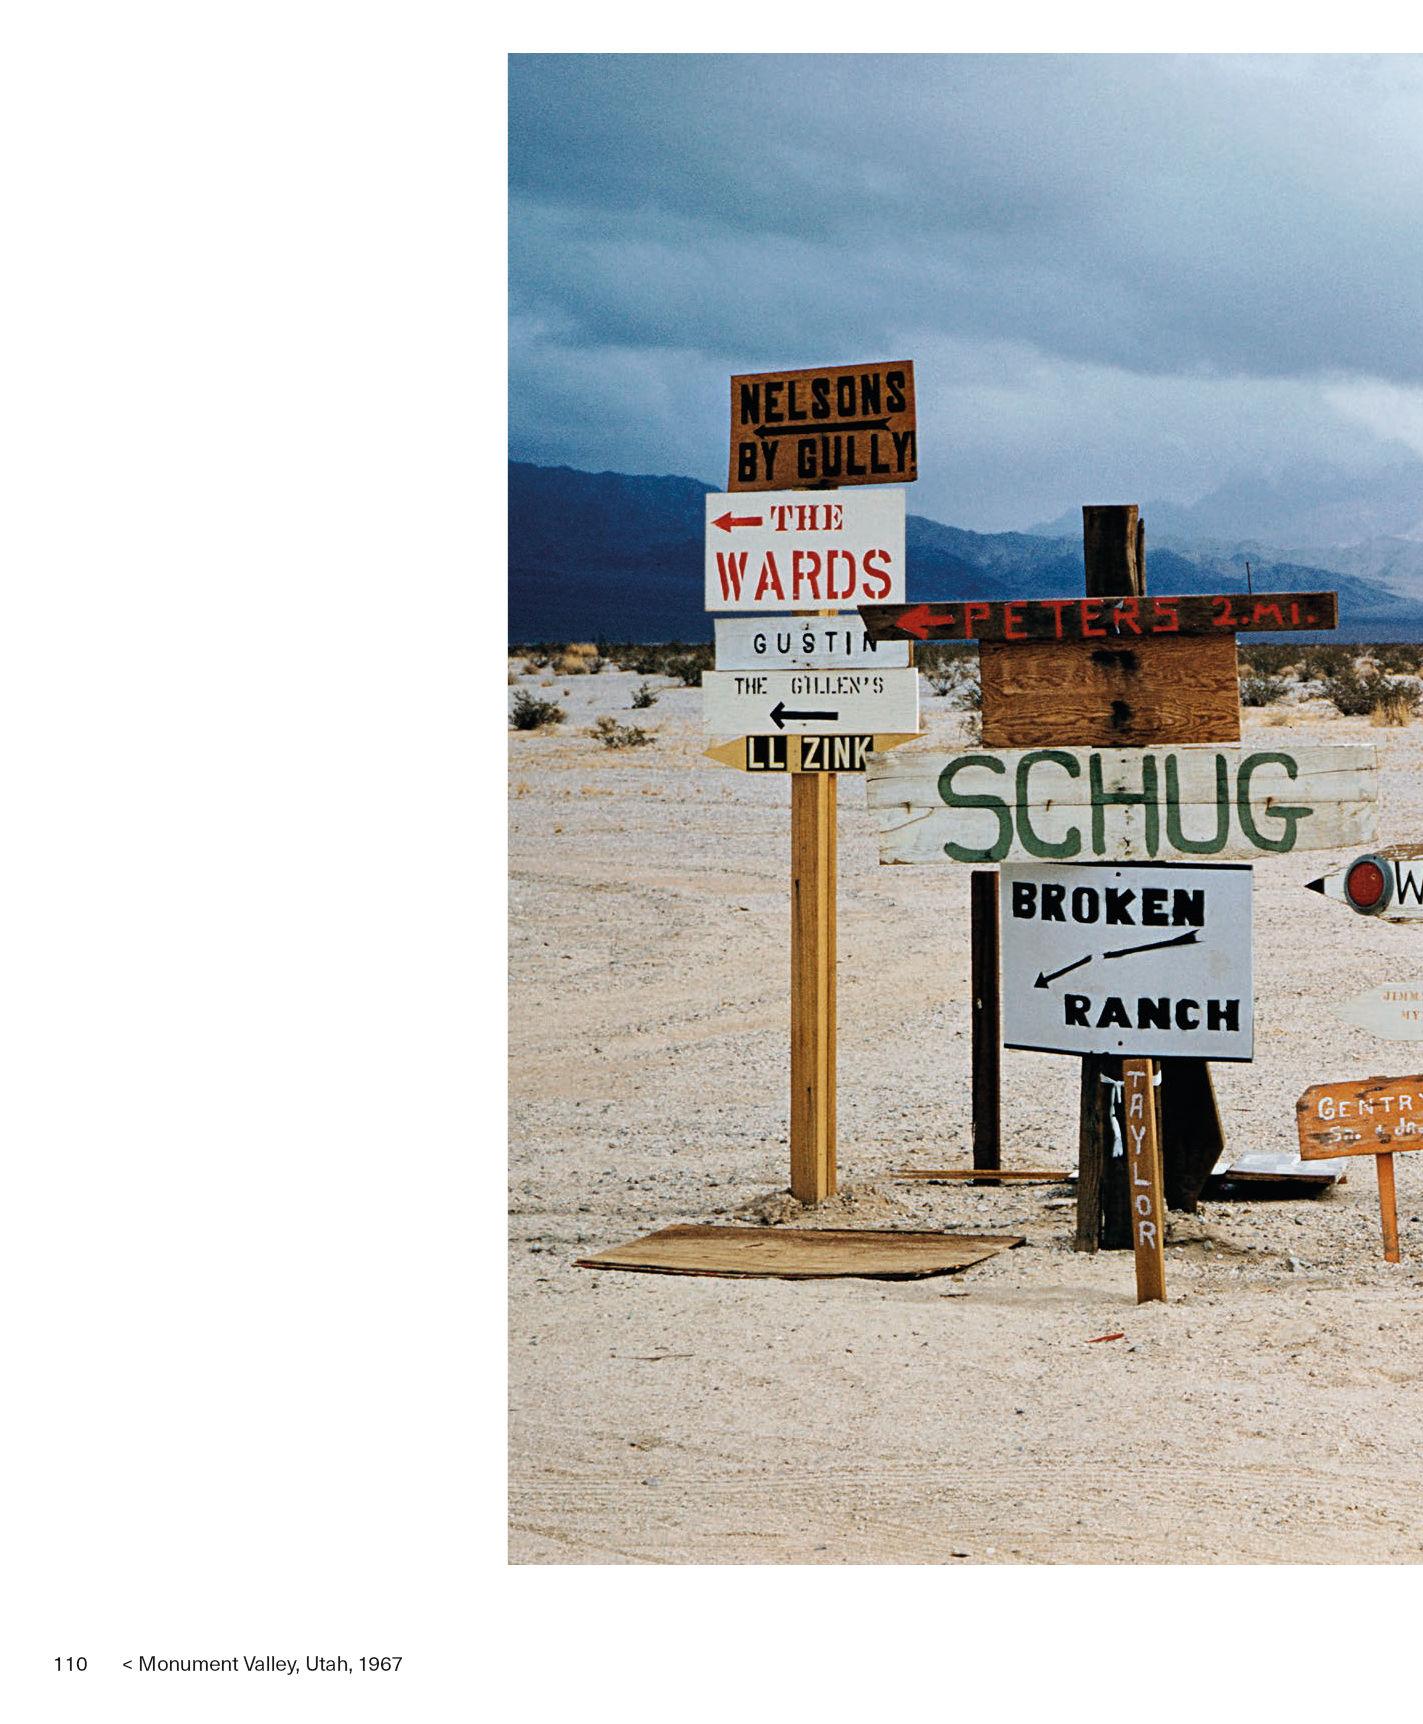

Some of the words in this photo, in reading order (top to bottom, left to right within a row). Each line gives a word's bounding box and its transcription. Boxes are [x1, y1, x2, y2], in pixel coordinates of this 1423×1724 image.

[740, 371, 906, 425] NELSONS
[738, 440, 778, 482] BY
[797, 431, 916, 479] GULLY!
[770, 504, 843, 532] THE
[716, 549, 893, 602] WARDS
[963, 598, 1181, 640] PETERS
[753, 631, 878, 655] GUSTIN
[734, 677, 768, 695] THE
[791, 676, 884, 694] GILLEN'S
[748, 736, 785, 769] LL
[803, 735, 872, 770] ZINK
[938, 750, 1314, 863] SCHUG
[1012, 881, 1205, 927] BROKEN
[1064, 993, 1240, 1031] RANCH
[1126, 1070, 1157, 1250] TAYLOR
